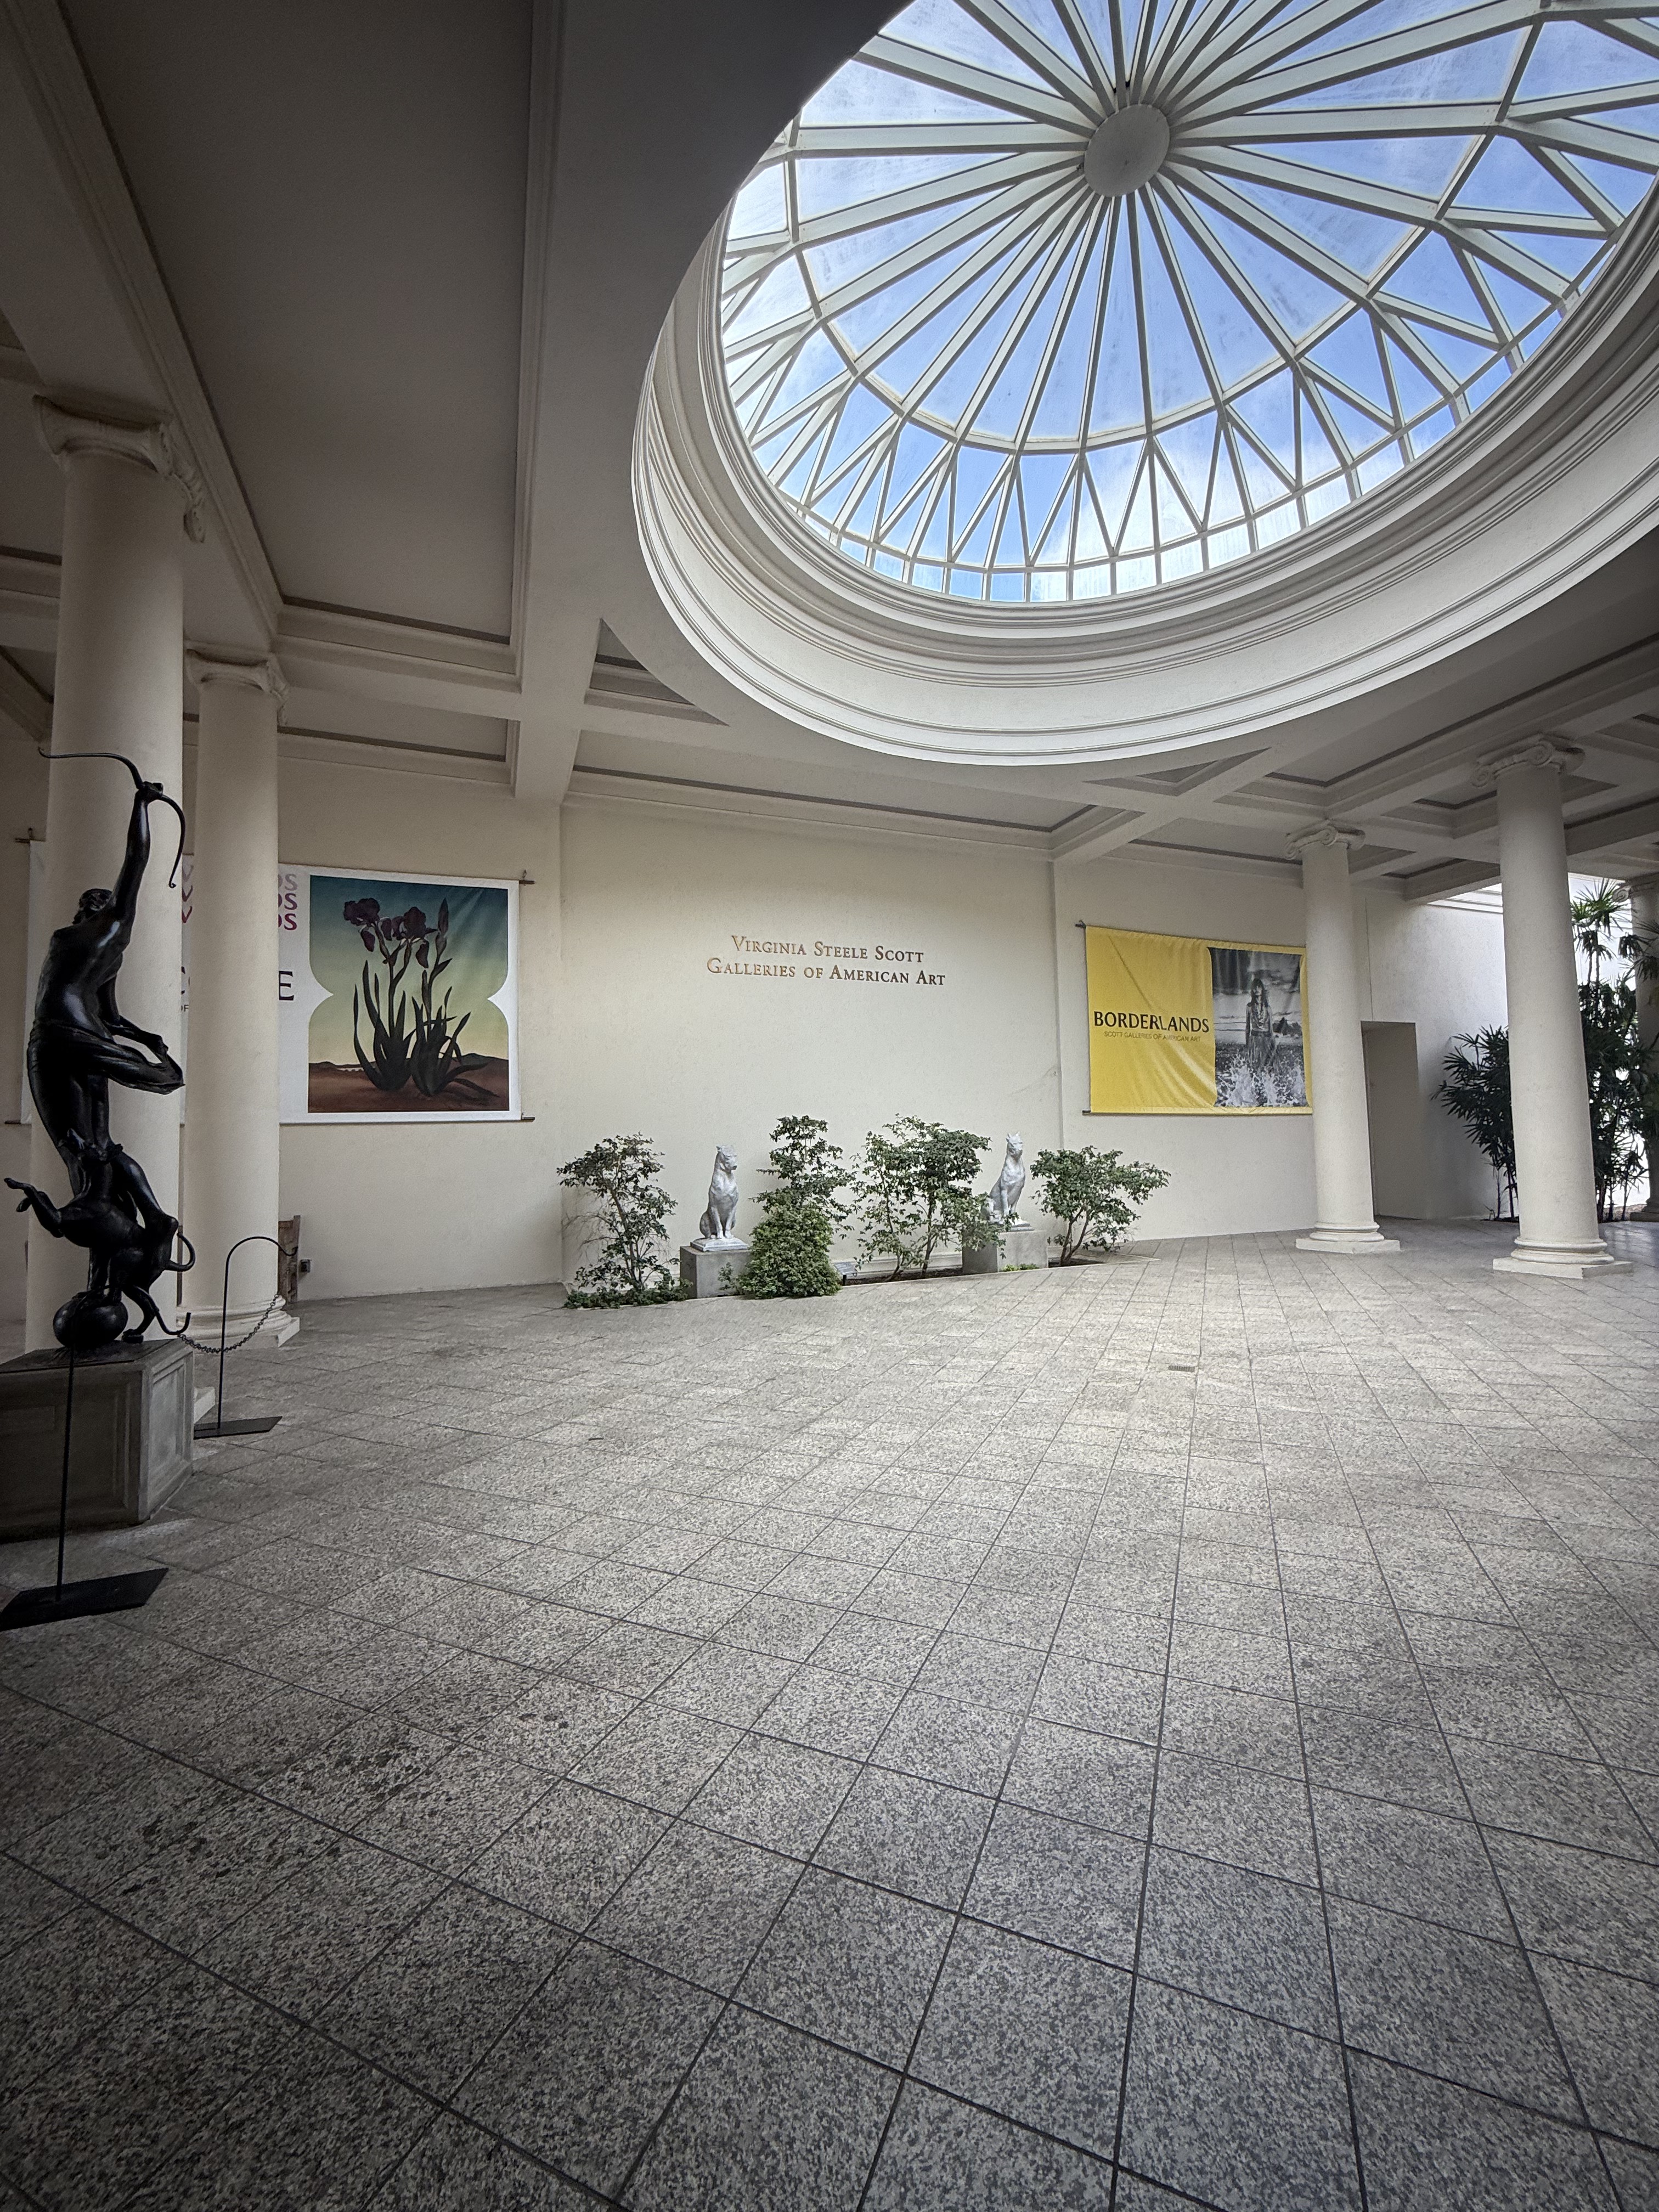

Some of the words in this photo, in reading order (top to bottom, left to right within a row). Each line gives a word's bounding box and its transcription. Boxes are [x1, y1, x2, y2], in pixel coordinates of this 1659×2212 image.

[731, 935, 807, 955] VIRGINIA
[814, 941, 868, 959] STEELE
[875, 945, 924, 962] SCOTT
[707, 957, 795, 977] GALLERIES
[829, 964, 909, 984] AMERICAN
[916, 970, 945, 985] ART
[1094, 1011, 1209, 1033] BORDERLANDS
